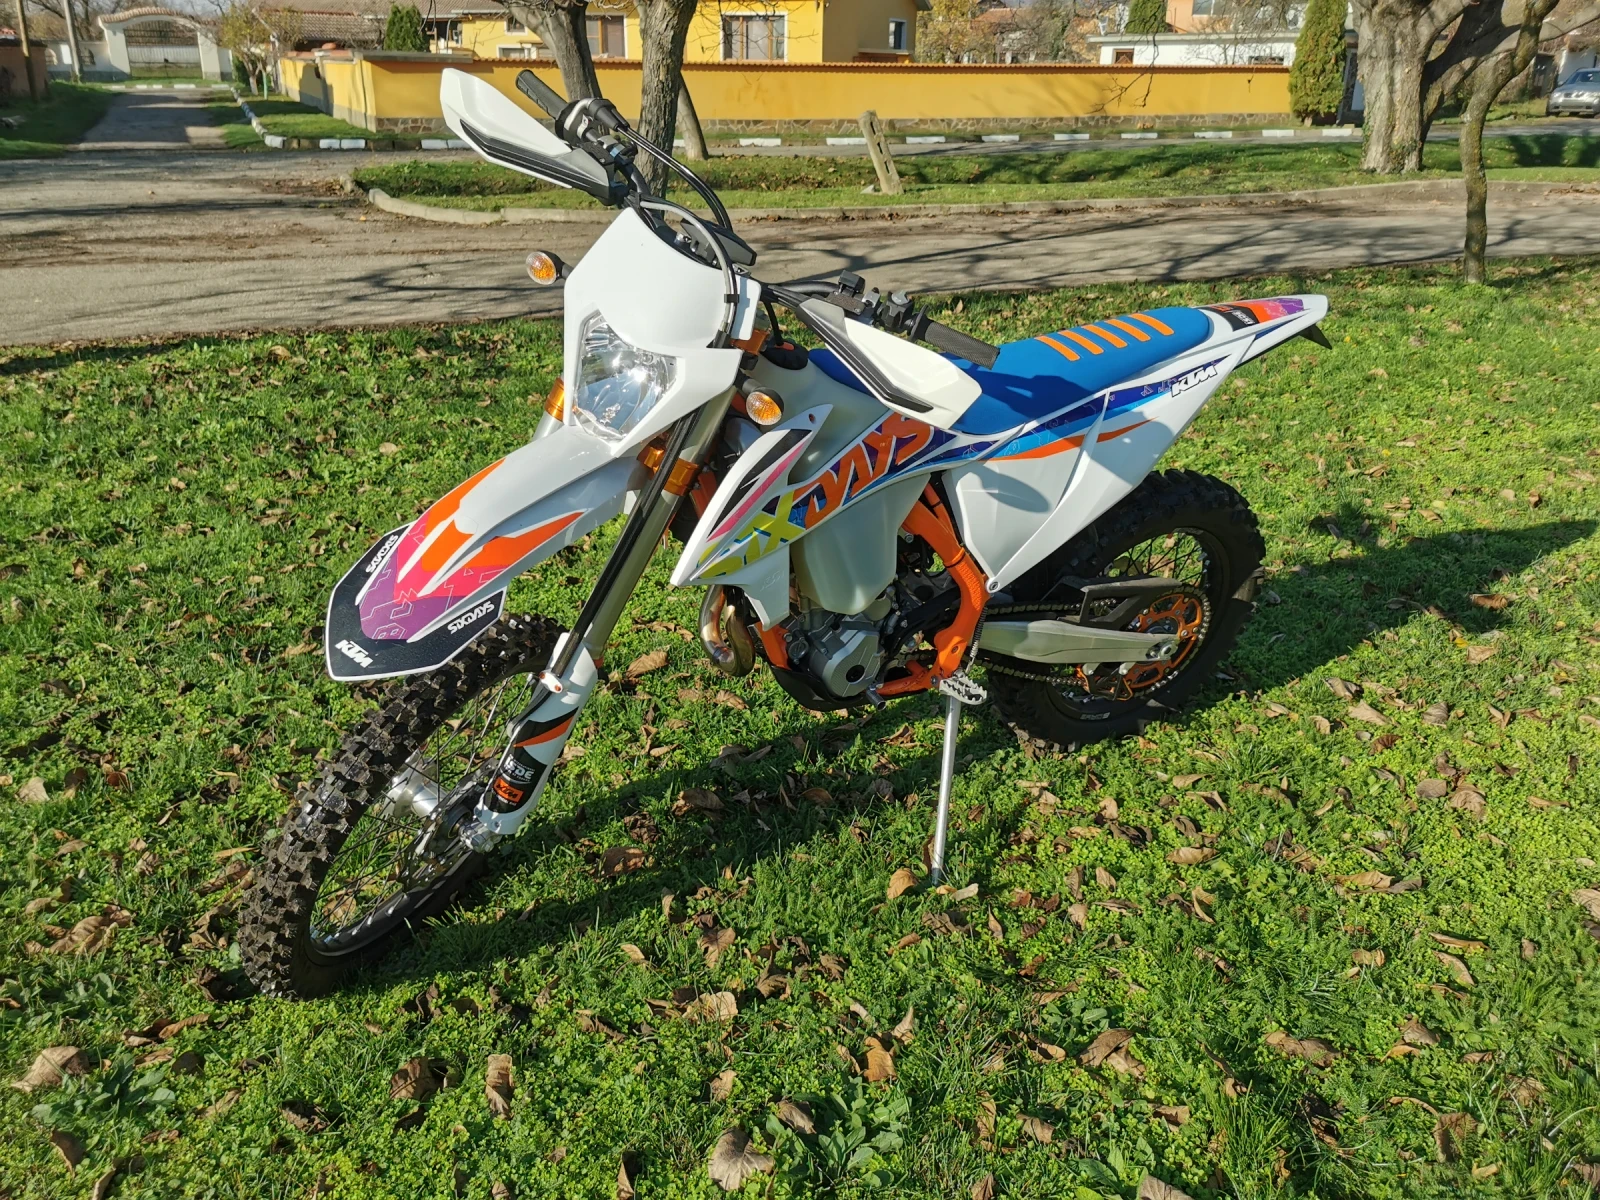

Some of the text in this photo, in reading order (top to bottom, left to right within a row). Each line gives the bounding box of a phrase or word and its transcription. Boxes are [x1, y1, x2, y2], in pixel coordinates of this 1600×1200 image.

[1172, 365, 1218, 397] KTM
[447, 600, 495, 635] SIXDAYS
[334, 639, 374, 668] KTM
